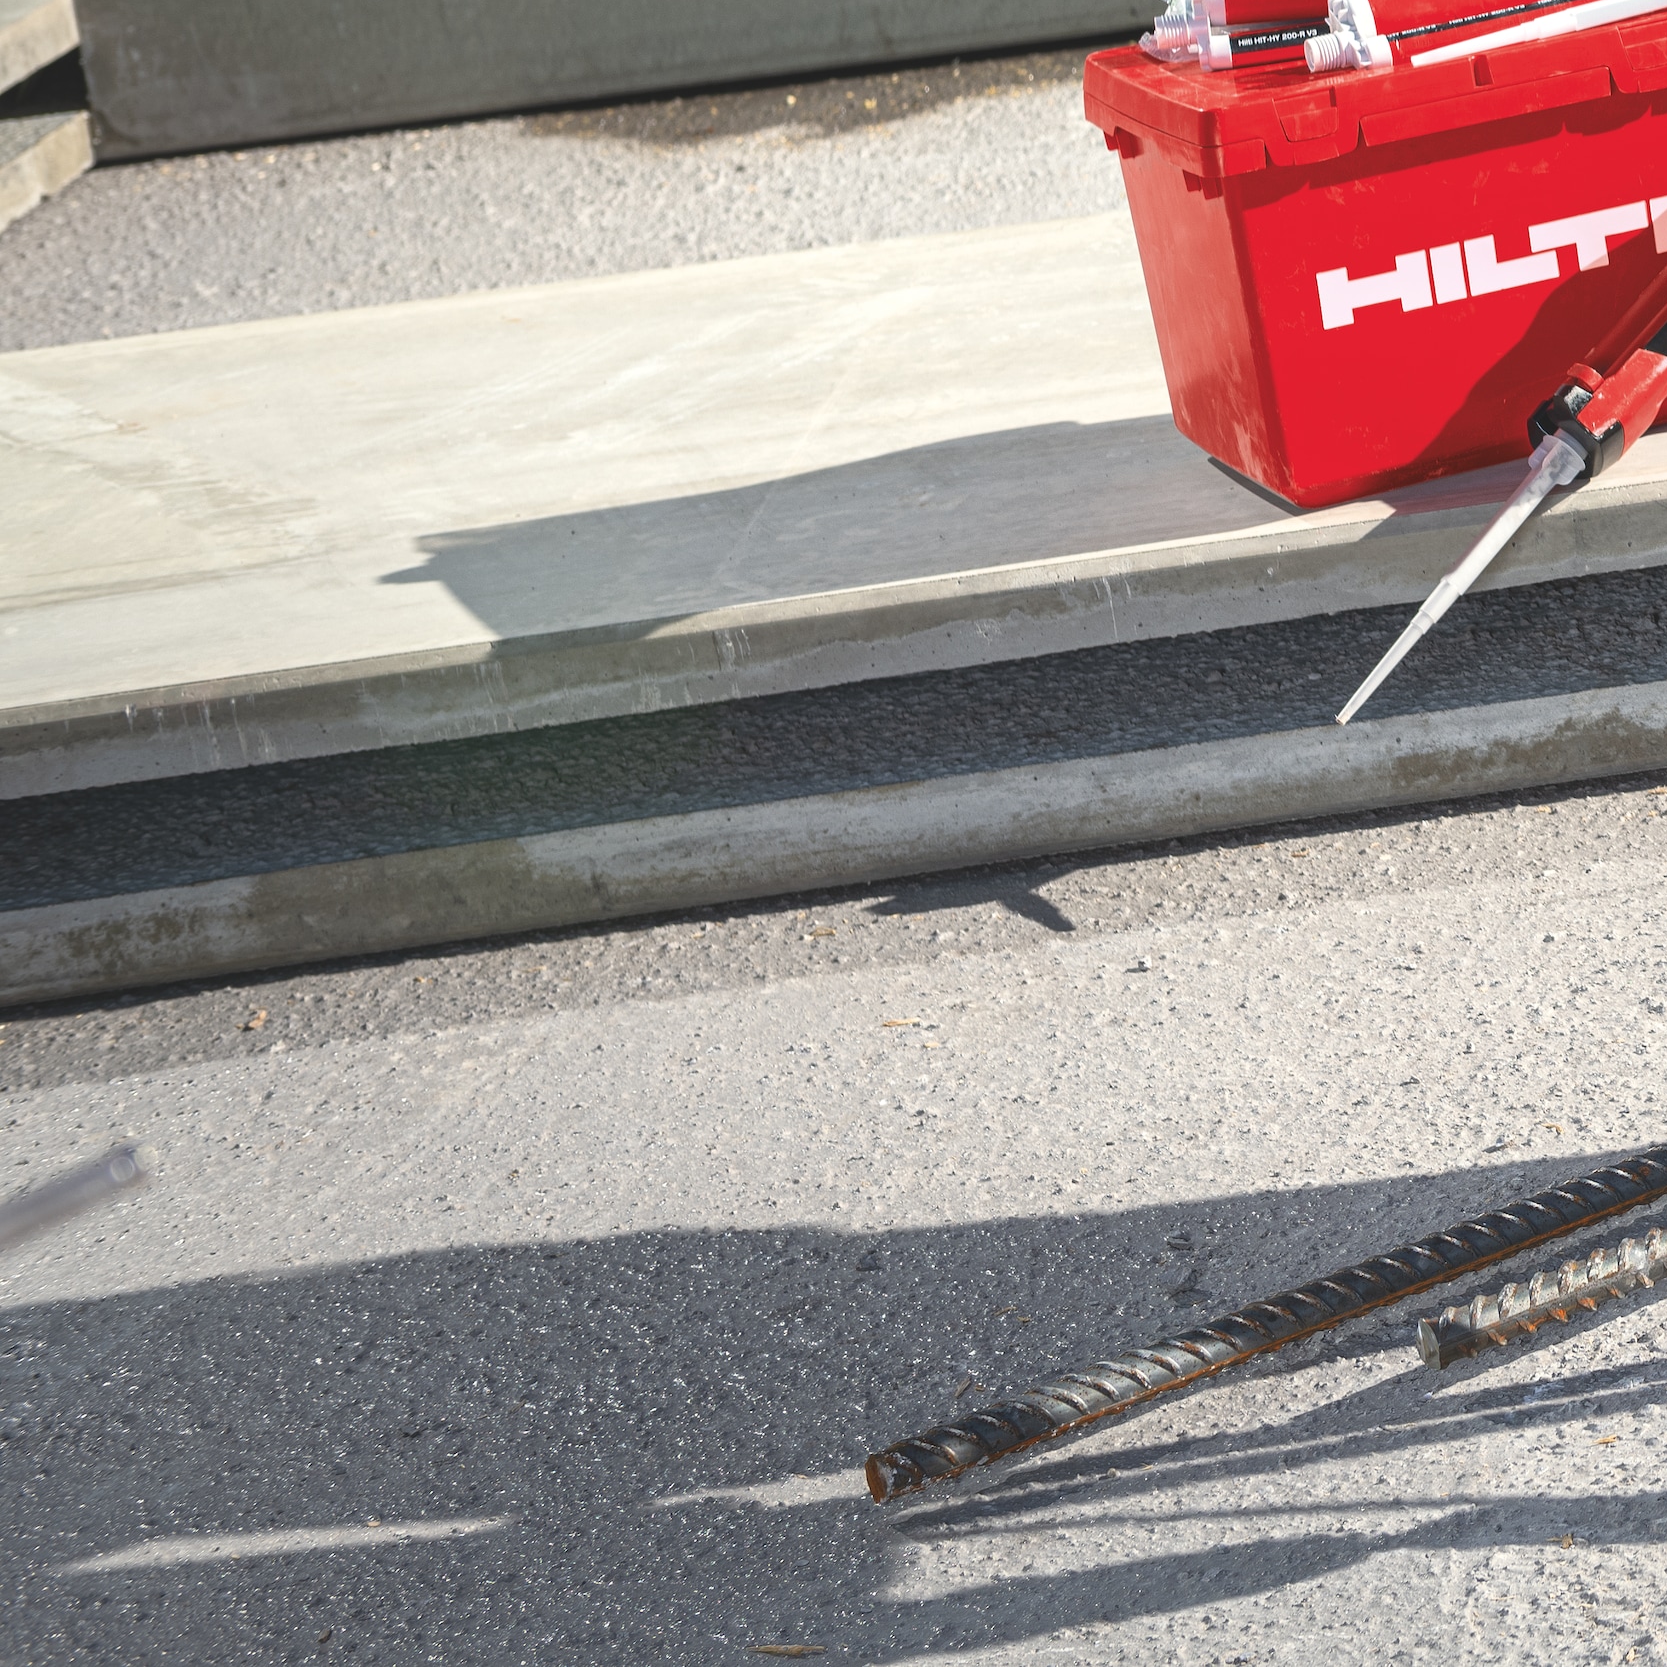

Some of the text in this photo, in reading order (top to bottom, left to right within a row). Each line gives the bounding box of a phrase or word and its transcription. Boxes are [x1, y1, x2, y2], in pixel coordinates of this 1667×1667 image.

[1238, 29, 1318, 47] Hilti HIT-HY 200-R V3
